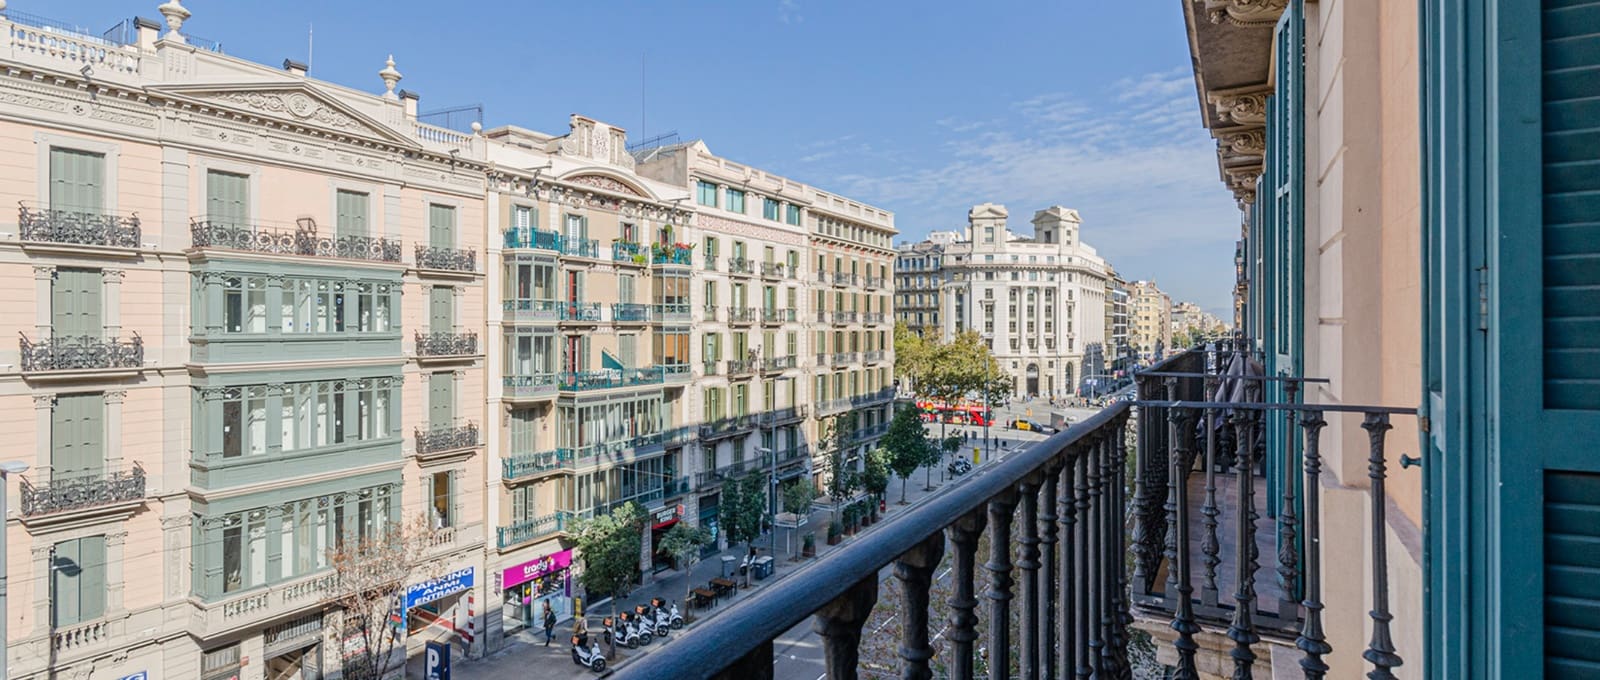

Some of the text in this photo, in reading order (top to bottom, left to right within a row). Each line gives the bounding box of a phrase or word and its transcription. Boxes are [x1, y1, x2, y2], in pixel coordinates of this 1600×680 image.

[408, 568, 472, 594] PARKING
[423, 579, 460, 596] ANMI
[415, 584, 466, 605] ENTRADA
[427, 647, 439, 676] P
